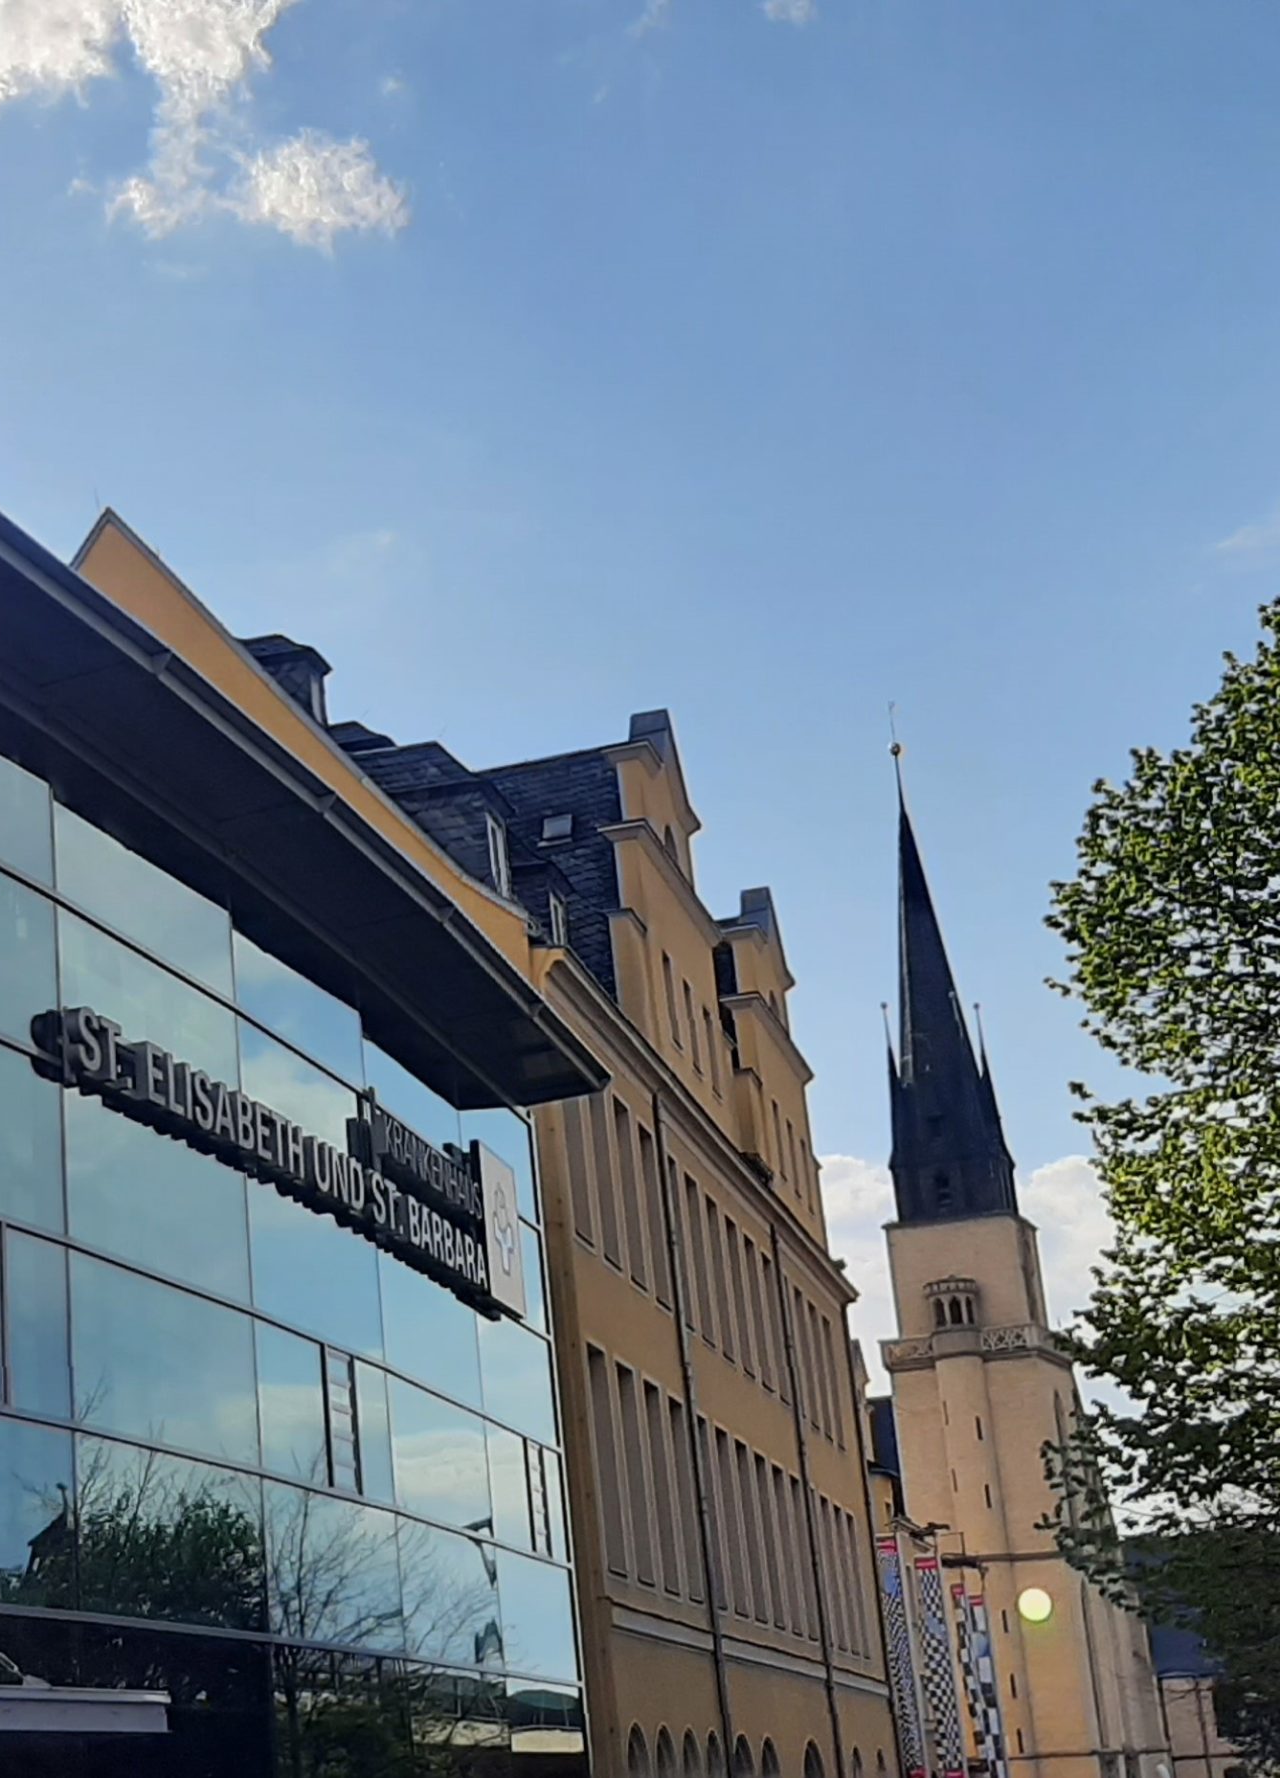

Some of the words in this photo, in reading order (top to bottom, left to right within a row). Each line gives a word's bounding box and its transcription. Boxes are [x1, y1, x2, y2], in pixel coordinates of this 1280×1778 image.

[77, 1006, 133, 1090] ST.
[147, 1041, 305, 1180] ELISABETH
[314, 1136, 365, 1210] UND
[370, 1171, 404, 1236] ST.
[408, 1194, 488, 1290] BARBARA
[384, 1115, 483, 1220] KRANKENHAUS
